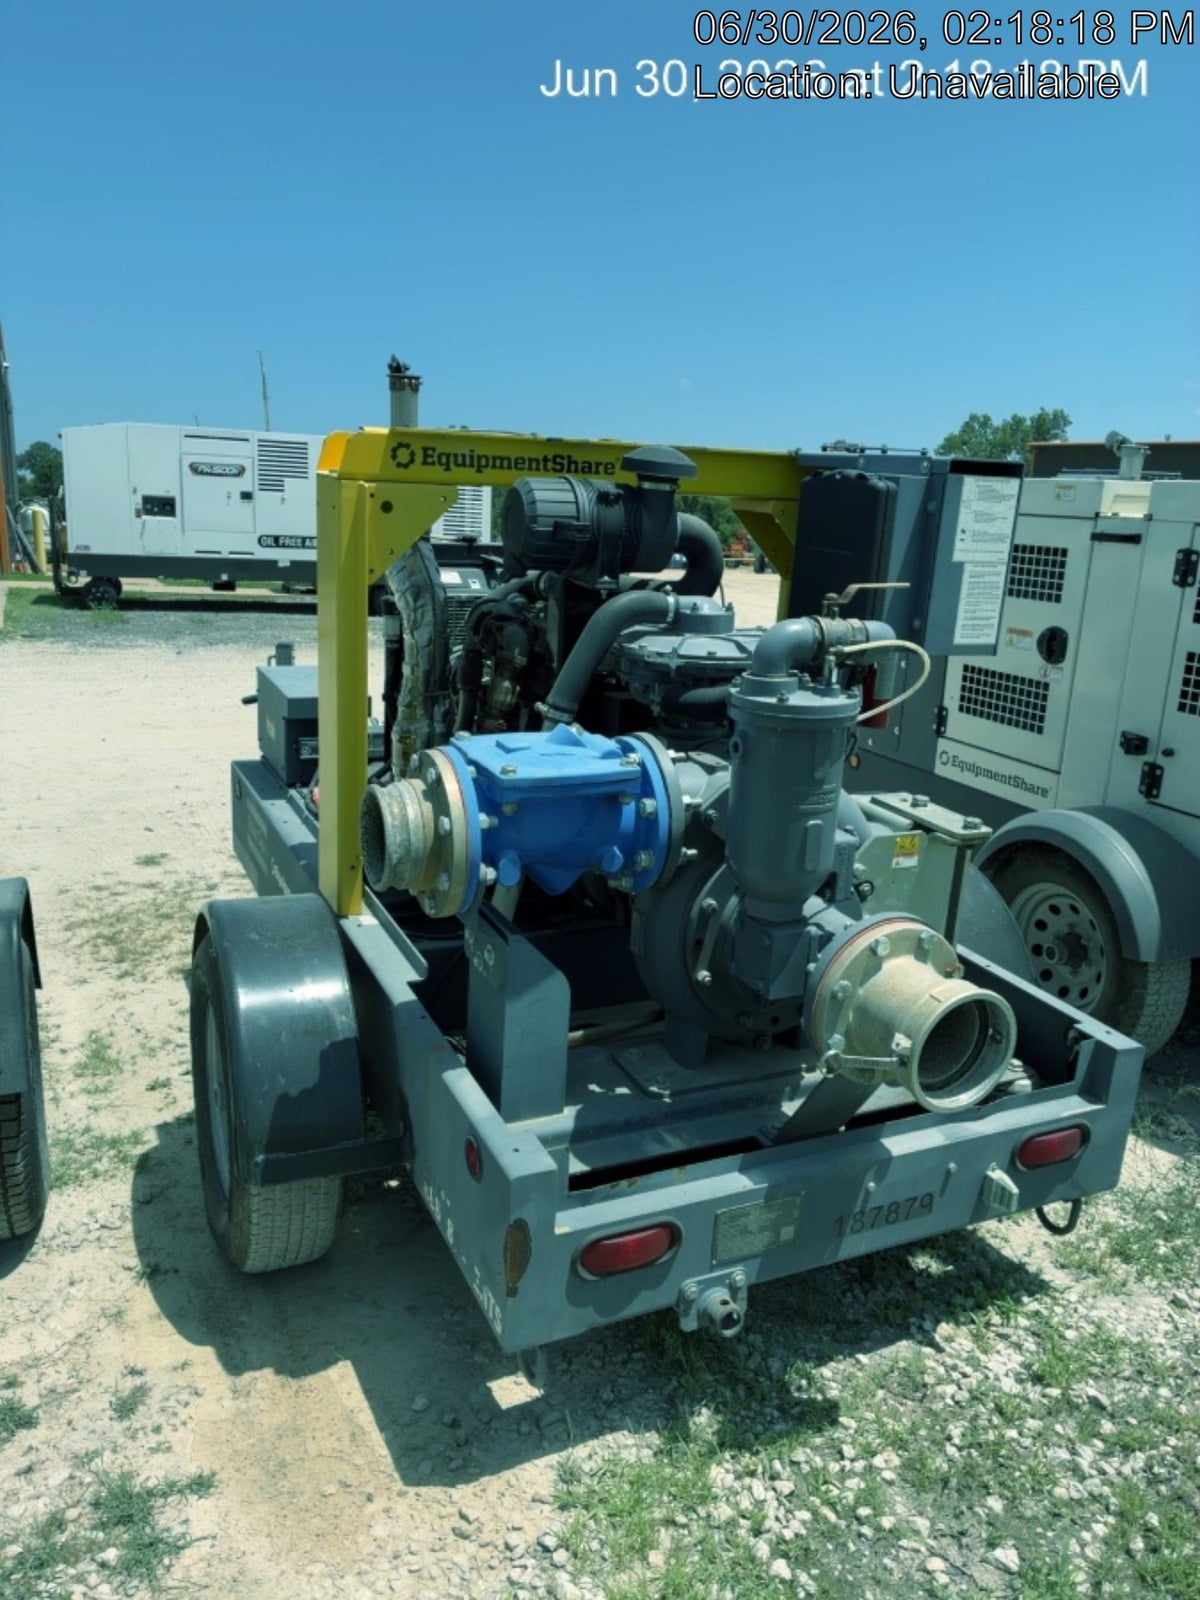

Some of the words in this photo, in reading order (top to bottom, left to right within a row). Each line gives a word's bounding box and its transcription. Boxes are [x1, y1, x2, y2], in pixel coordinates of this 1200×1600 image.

[420, 446, 616, 476] EquipmentShare
[951, 755, 1049, 799] EquipmentShare
[834, 1192, 935, 1238] 187879
